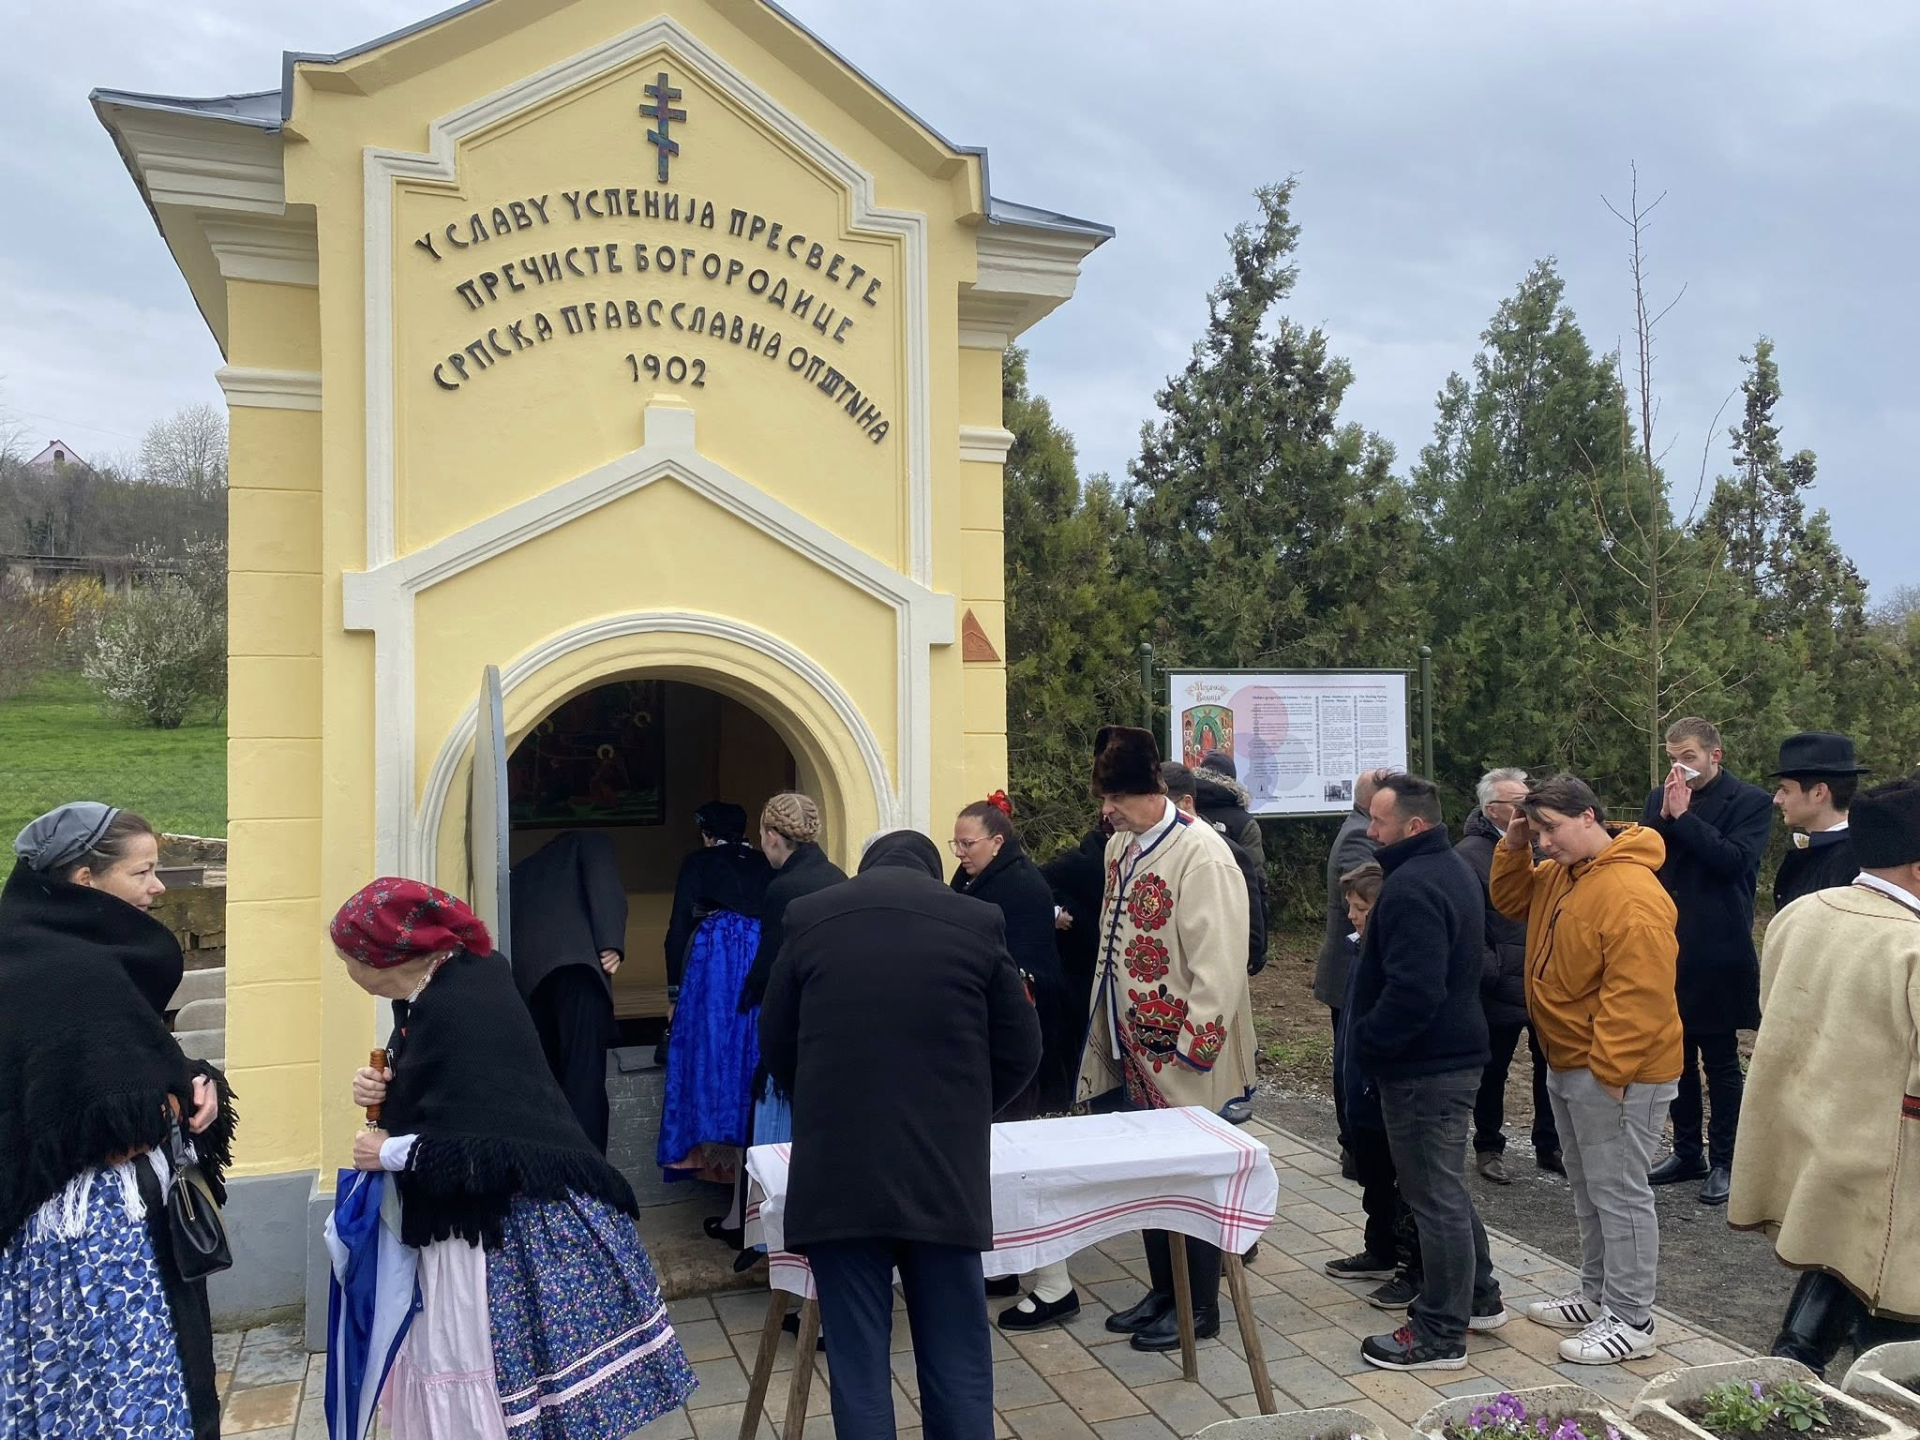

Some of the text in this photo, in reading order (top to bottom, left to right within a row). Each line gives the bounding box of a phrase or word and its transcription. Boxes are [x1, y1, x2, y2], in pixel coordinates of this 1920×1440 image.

[414, 188, 882, 308] У СЛАВУ УСПЕНИЈА ПРЕСВЕТЕ
[455, 243, 854, 344] ПРЕЧИСТЕ БОГОРОДИЦЕ
[433, 312, 553, 391] СРПСКА
[787, 346, 890, 445] ОПШТИНА
[625, 353, 706, 389] 1902
